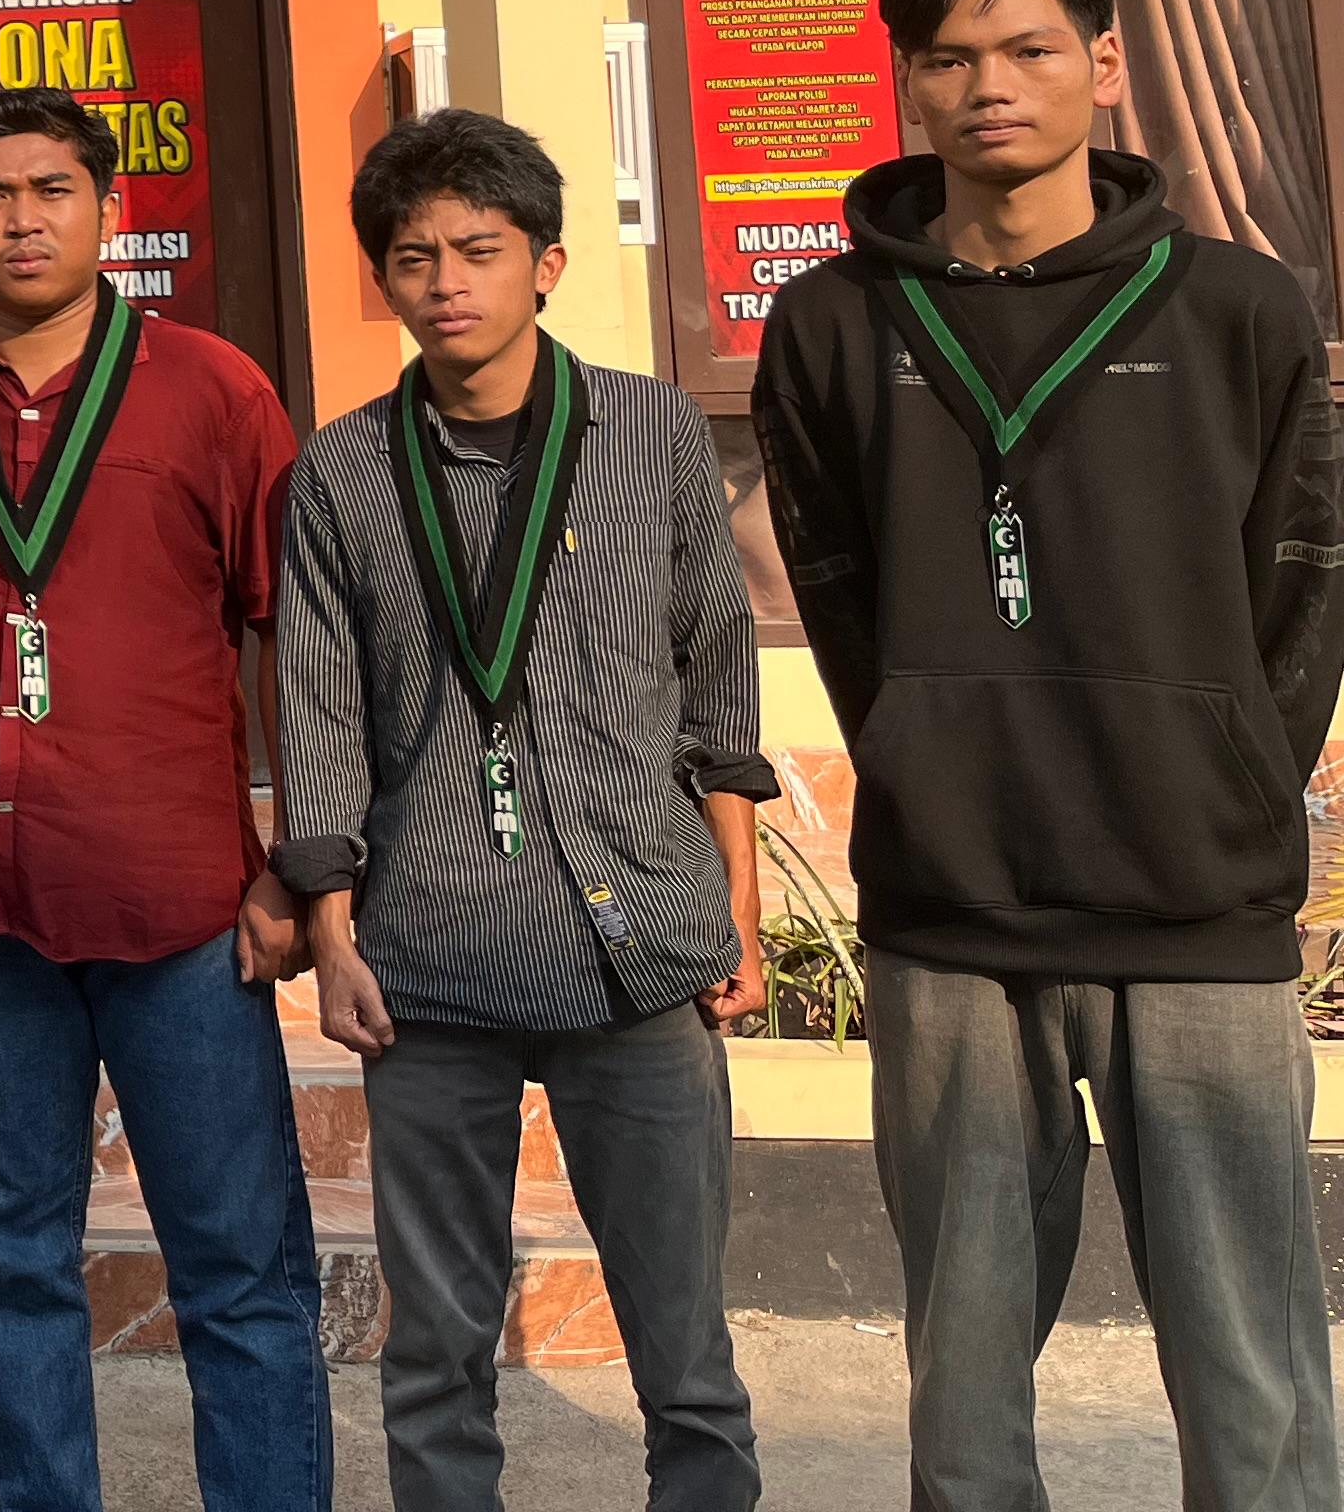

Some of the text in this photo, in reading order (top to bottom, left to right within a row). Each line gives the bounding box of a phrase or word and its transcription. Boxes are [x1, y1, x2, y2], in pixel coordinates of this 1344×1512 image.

[707, 16, 729, 25] YANG
[732, 14, 757, 24] DAPAT
[752, 28, 778, 37] CEPAT
[781, 26, 798, 36] DAN
[751, 40, 824, 53] KEPADA PELAPOR
[706, 78, 774, 89] PERKEMBANGAN
[837, 73, 877, 84] PERKARA
[758, 90, 826, 101] LAPORAN POLISI
[729, 107, 756, 117] MULAI
[807, 104, 835, 114] MARET
[718, 123, 743, 133] DAPAT
[834, 117, 872, 127] WEBSITE
[761, 135, 793, 146] ONLINE
[795, 134, 818, 144] YANG
[831, 132, 859, 142] AKSES
[766, 149, 788, 159] PADA
[737, 223, 849, 253] MUDAH,
[999, 556, 1025, 620] HMI
[22, 656, 46, 715] HMI
[493, 791, 518, 854] HMI
